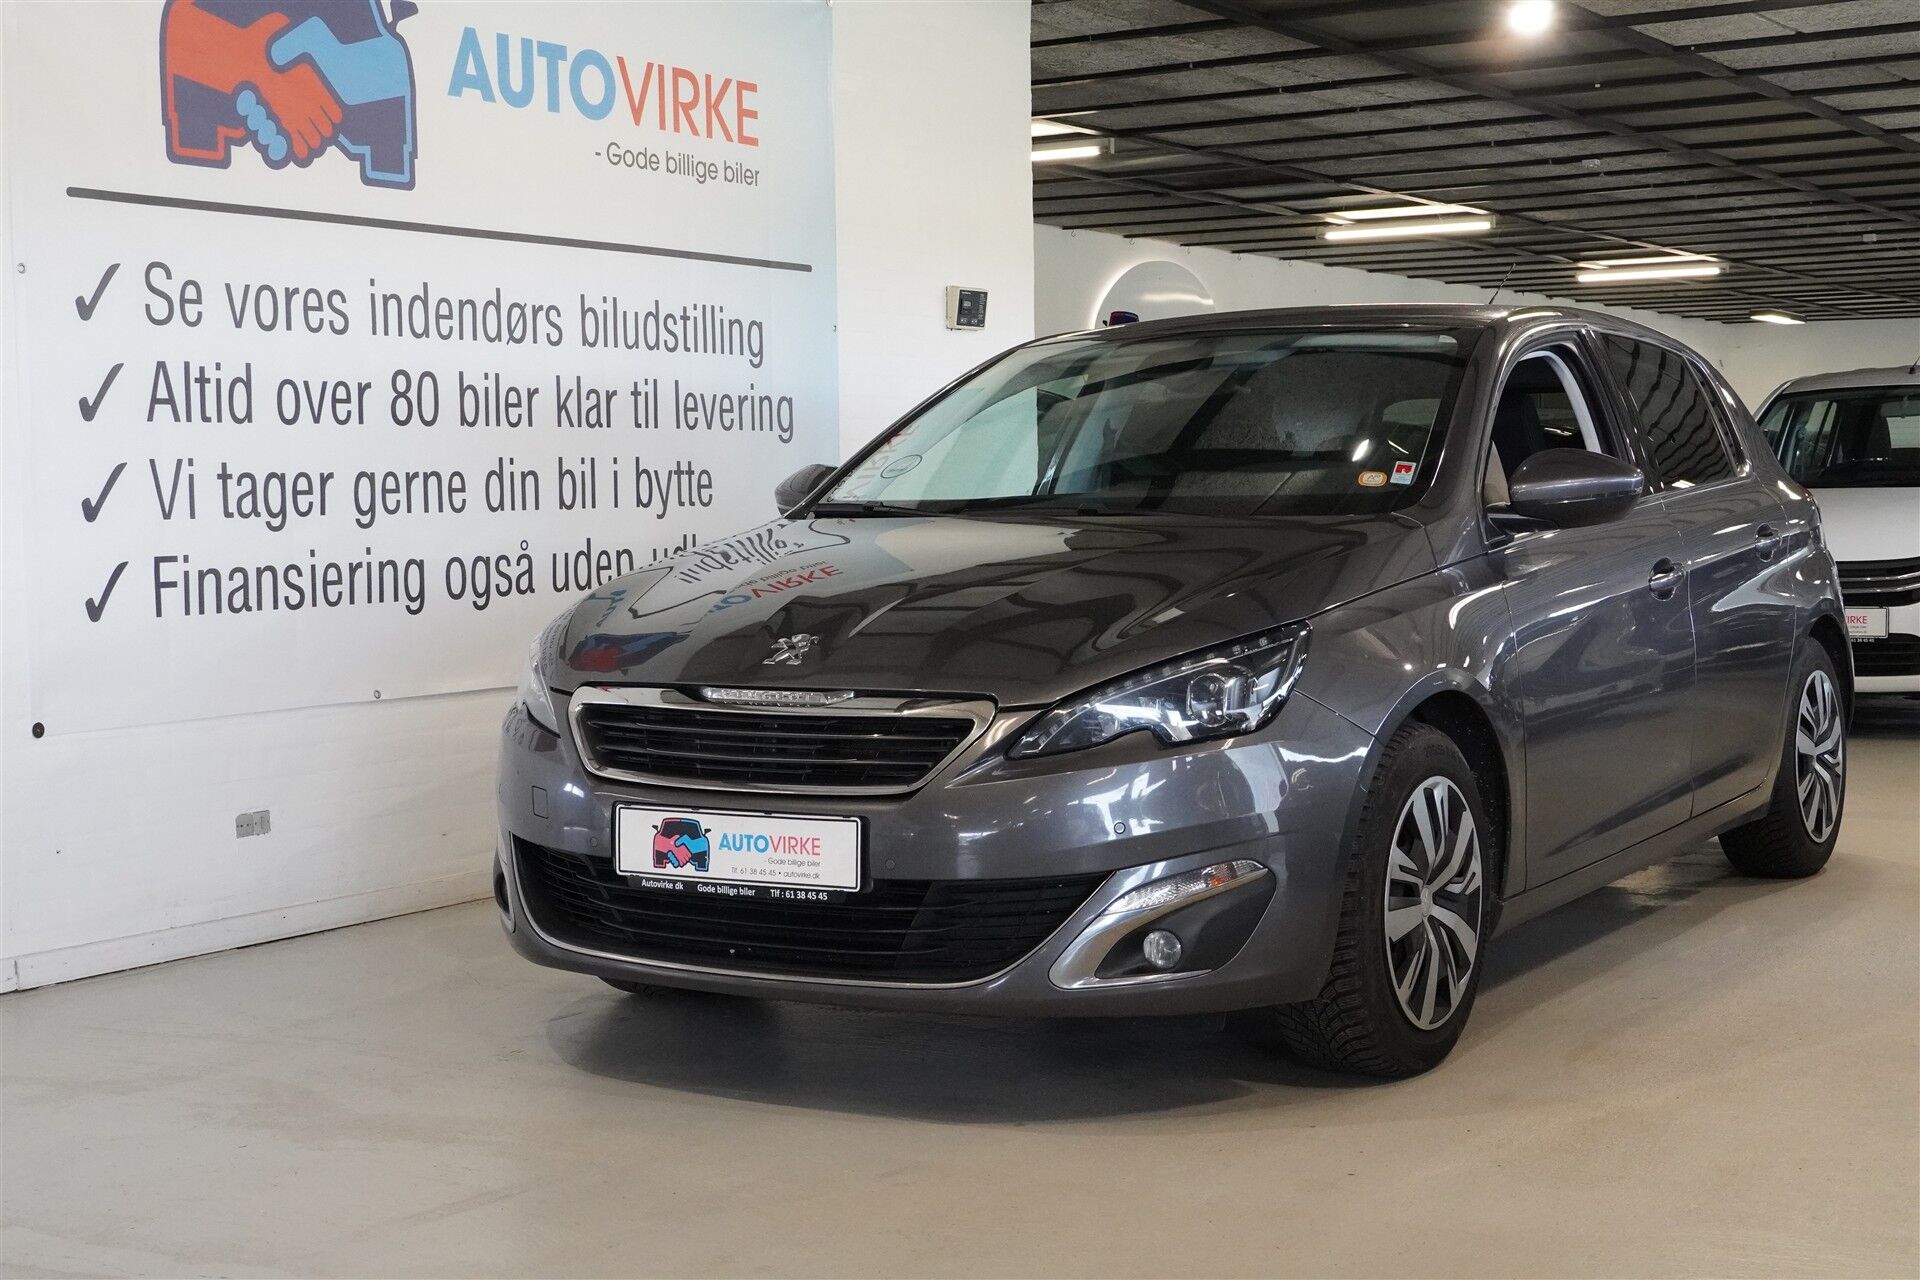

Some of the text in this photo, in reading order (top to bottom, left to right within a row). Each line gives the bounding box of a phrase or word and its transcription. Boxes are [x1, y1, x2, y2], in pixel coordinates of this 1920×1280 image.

[449, 27, 759, 147] AUTOVIRKE
[606, 141, 660, 172] Gode
[665, 150, 719, 184] billige
[723, 160, 760, 186] biler
[145, 261, 764, 369] Se vores indendørs biludstilling
[147, 361, 794, 444] Altid over 80 biler klar til levering
[149, 456, 713, 533] Vi tager gerne din bil i bytte
[154, 554, 426, 618] Finansiering
[446, 539, 536, 612] også
[553, 538, 635, 593] uden
[718, 832, 821, 856] AUTOVIRKE
[641, 879, 673, 889] Autovirke
[675, 882, 684, 890] dk
[697, 884, 715, 893] Gode
[717, 885, 737, 896] billige
[740, 887, 756, 896] biler
[785, 890, 795, 899] 61
[796, 891, 806, 899] 38
[807, 892, 817, 900] 45
[818, 892, 828, 901] 45
